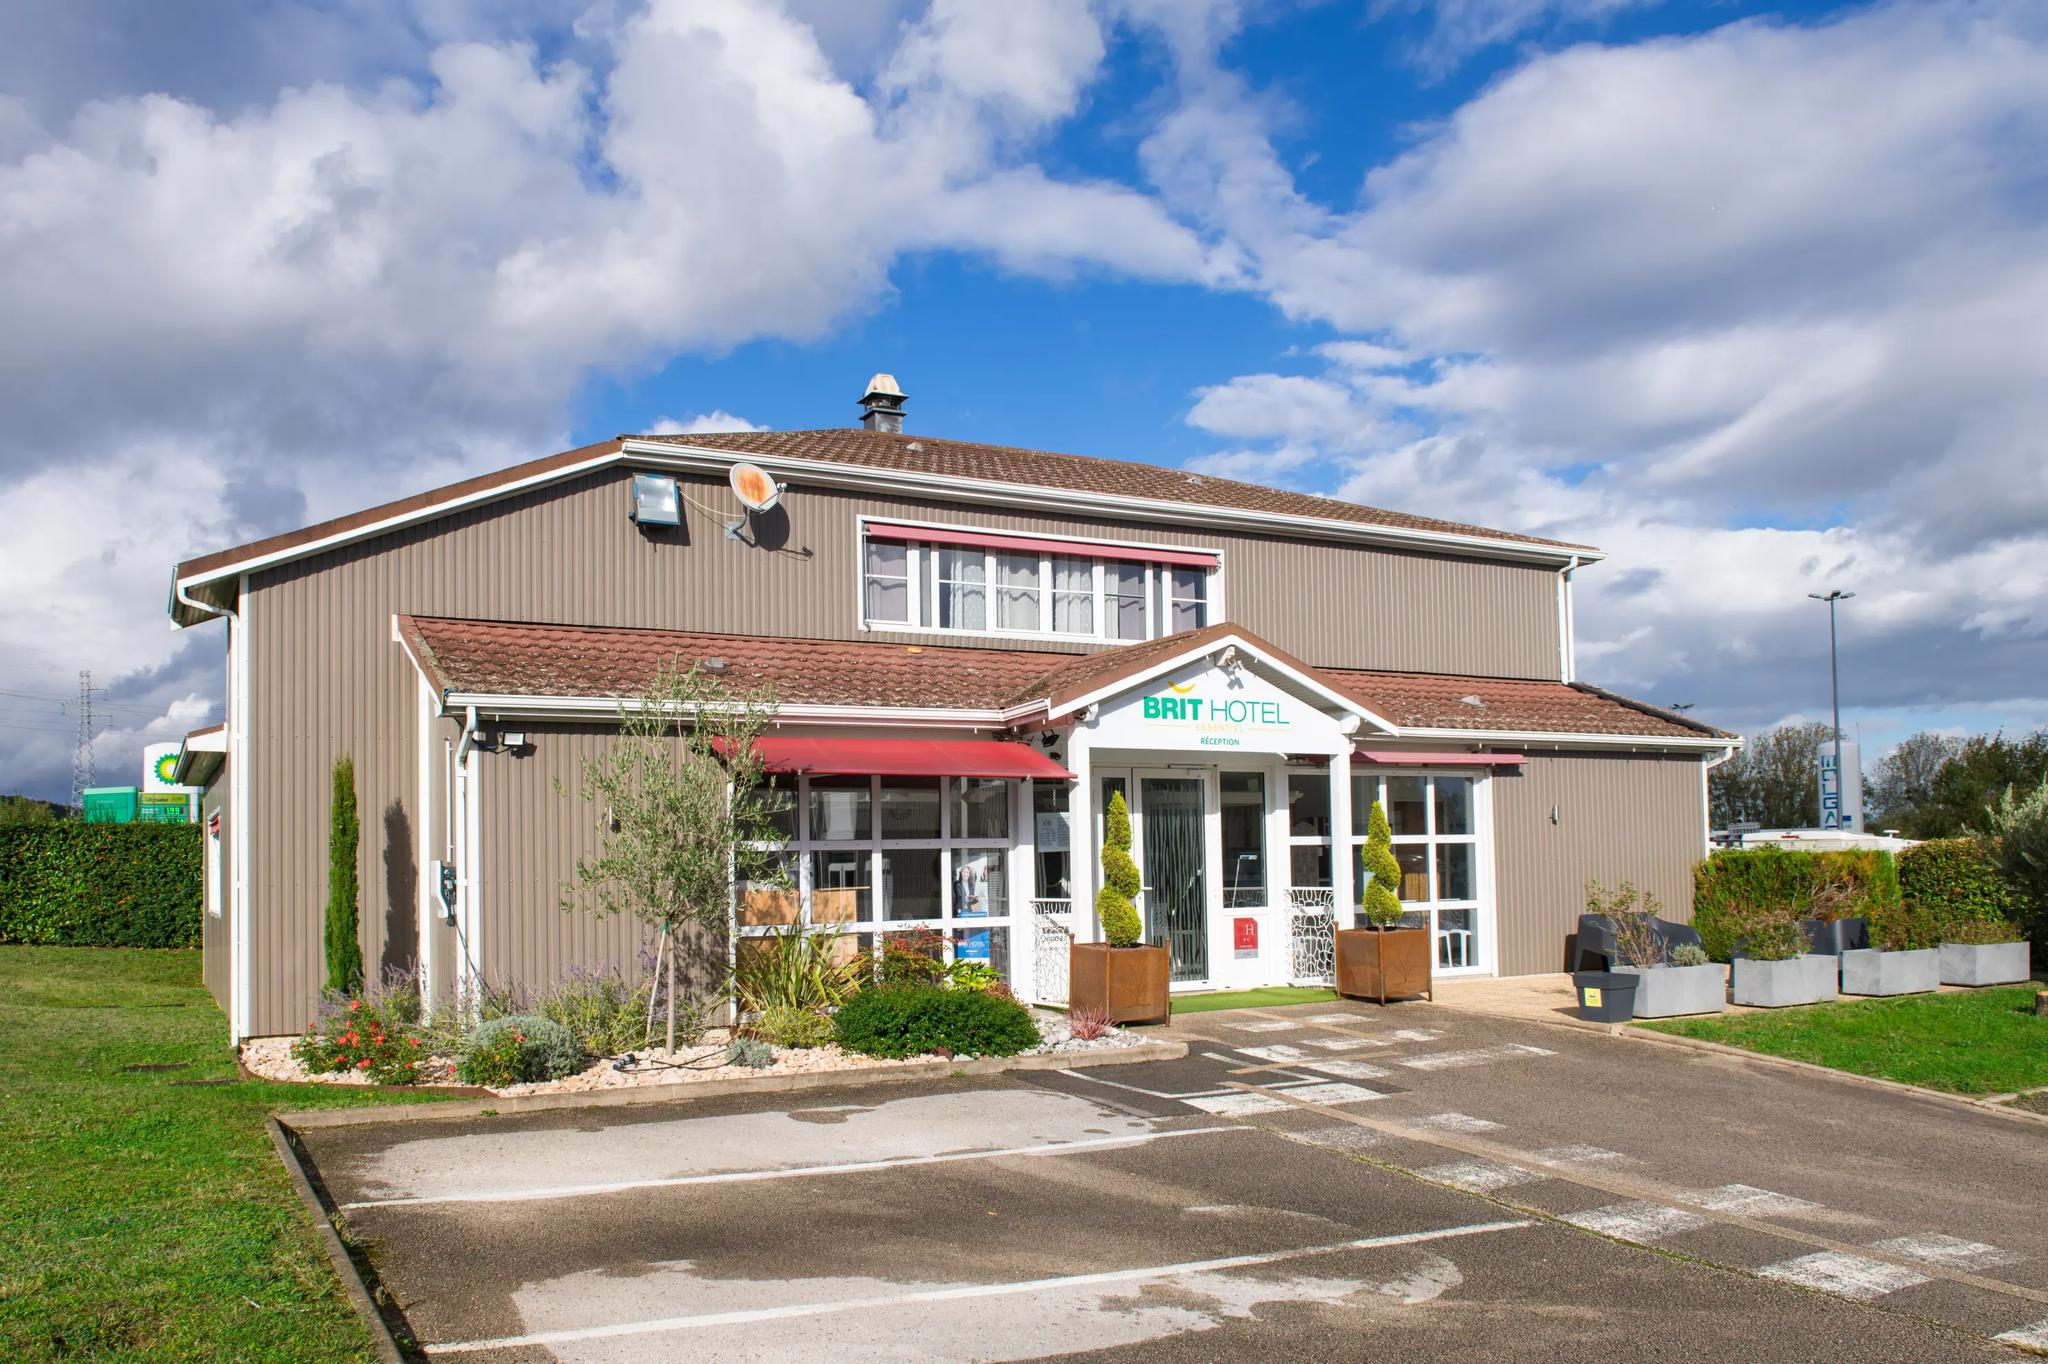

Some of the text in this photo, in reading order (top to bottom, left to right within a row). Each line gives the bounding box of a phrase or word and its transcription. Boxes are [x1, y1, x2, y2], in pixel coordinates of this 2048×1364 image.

[1144, 696, 1290, 725] BRIT HOTEL
[1200, 736, 1240, 746] RÉCEPTION
[1246, 924, 1254, 936] H
